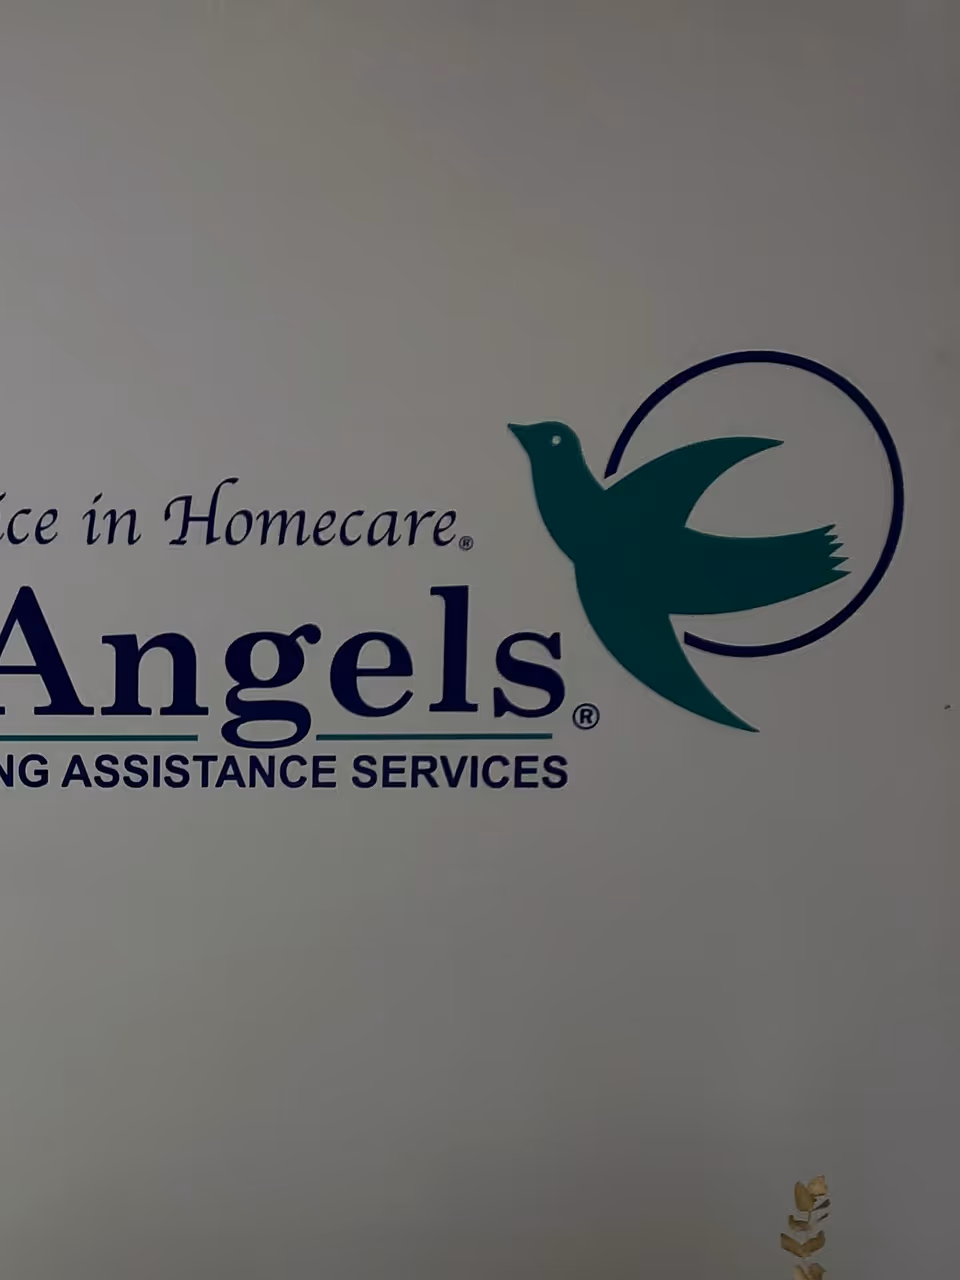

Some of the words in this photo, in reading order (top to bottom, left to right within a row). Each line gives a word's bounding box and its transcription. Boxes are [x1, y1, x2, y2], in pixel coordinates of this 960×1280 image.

[82, 492, 142, 546] in
[61, 753, 337, 789] ASSISTANCE
[351, 753, 569, 789] SERVICES
